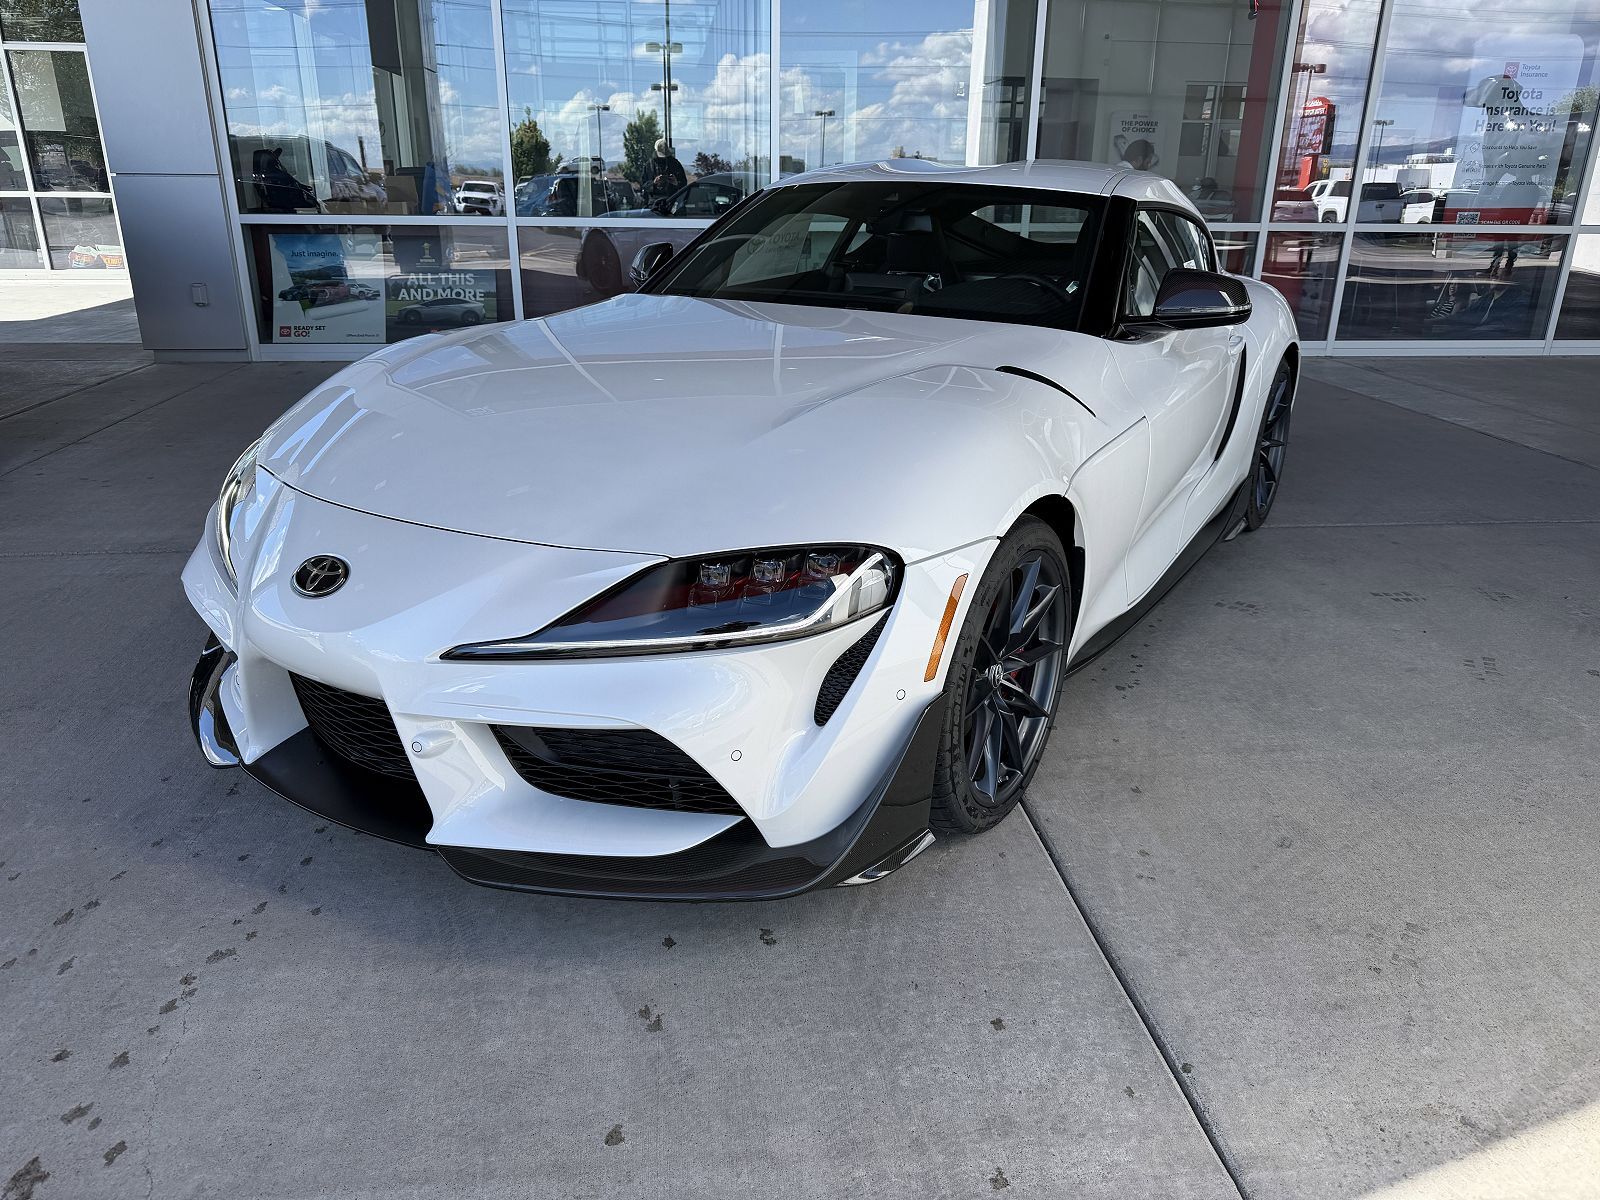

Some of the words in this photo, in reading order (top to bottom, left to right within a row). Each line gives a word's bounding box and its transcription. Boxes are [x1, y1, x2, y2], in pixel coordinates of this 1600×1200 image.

[1522, 63, 1541, 72] Toyota
[1501, 87, 1543, 103] Toyota
[1481, 103, 1542, 116] Insurance
[1545, 103, 1556, 116] is
[1475, 119, 1504, 132] Here
[1529, 119, 1557, 132] You!
[290, 250, 306, 258] Just
[307, 250, 339, 259] imagine.
[407, 272, 436, 285] ALL
[438, 273, 475, 285] THIS
[398, 288, 434, 301] AND
[437, 288, 485, 301] MORE
[293, 330, 311, 338] GO!
